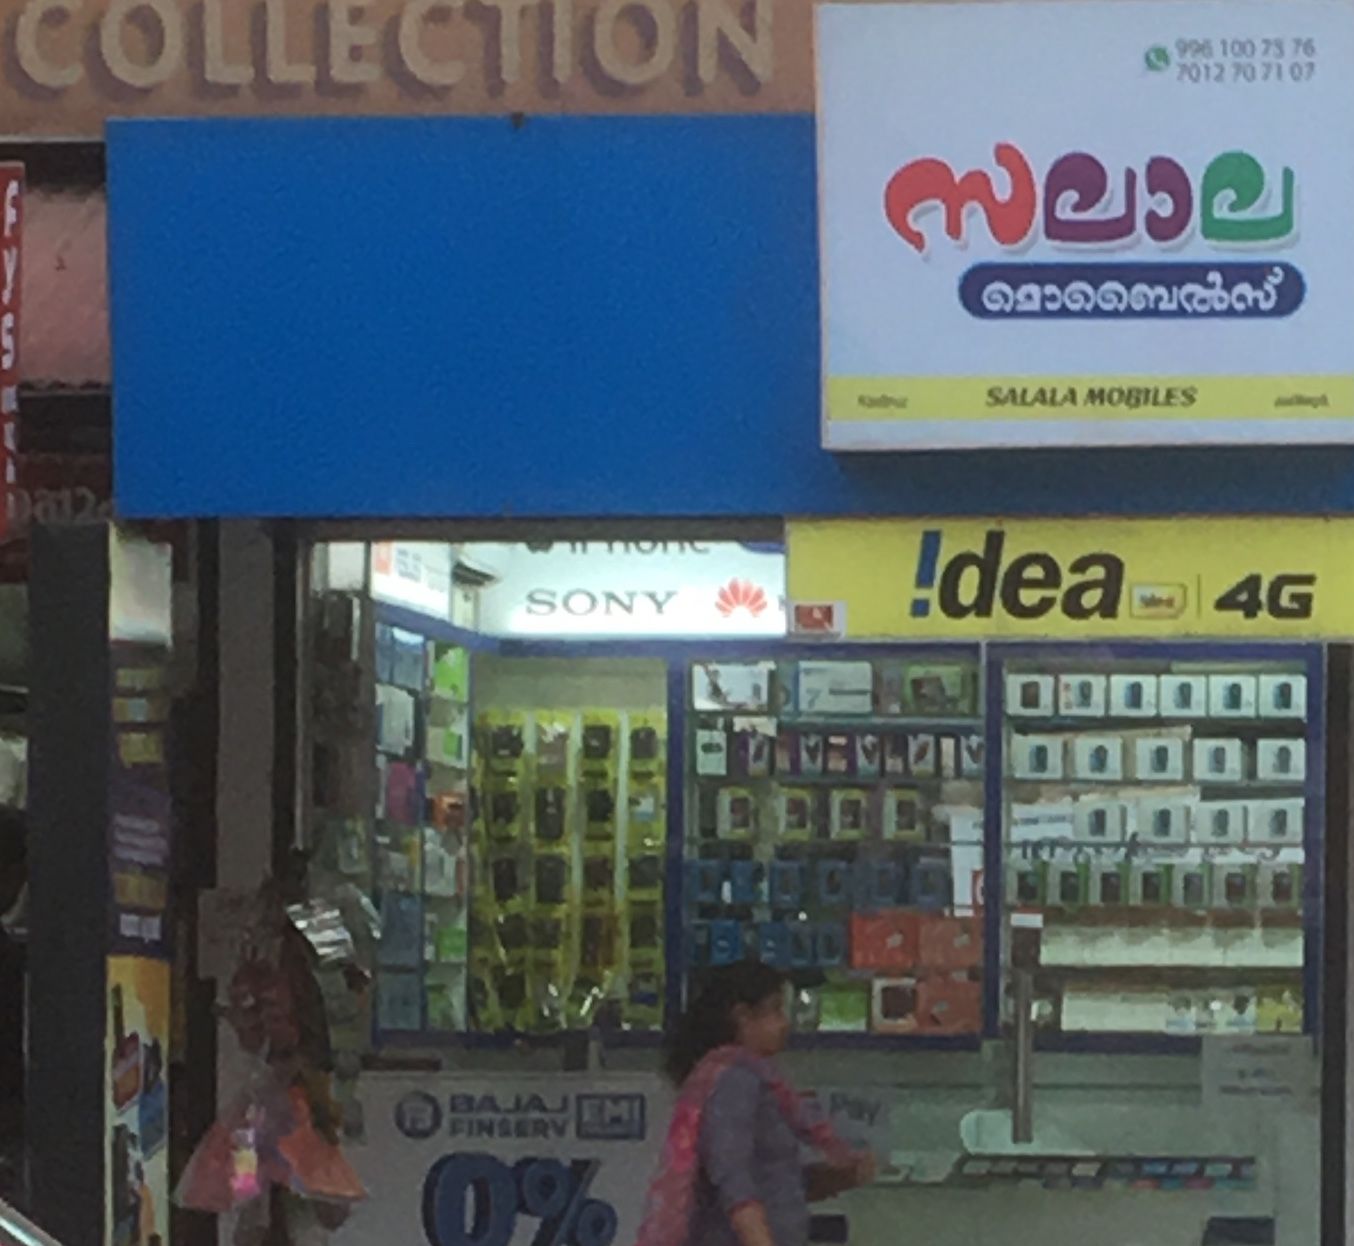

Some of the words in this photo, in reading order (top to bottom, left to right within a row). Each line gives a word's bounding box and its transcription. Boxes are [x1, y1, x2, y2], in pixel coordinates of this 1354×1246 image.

[15, 0, 775, 87] COLLECTION
[1220, 38, 1256, 57] 100
[1232, 62, 1256, 82] 70
[1262, 62, 1283, 81] 71
[1290, 62, 1315, 81] 07
[884, 142, 1294, 254] സലാല
[982, 267, 1284, 312] മൊബൈൽസ്
[986, 386, 1080, 408] SALALA
[1083, 386, 1198, 408] MOBILES
[525, 588, 678, 616] SONY
[1214, 574, 1317, 619] 4G
[450, 1095, 569, 1114] BAJAJ
[450, 1119, 567, 1138] FINSERV
